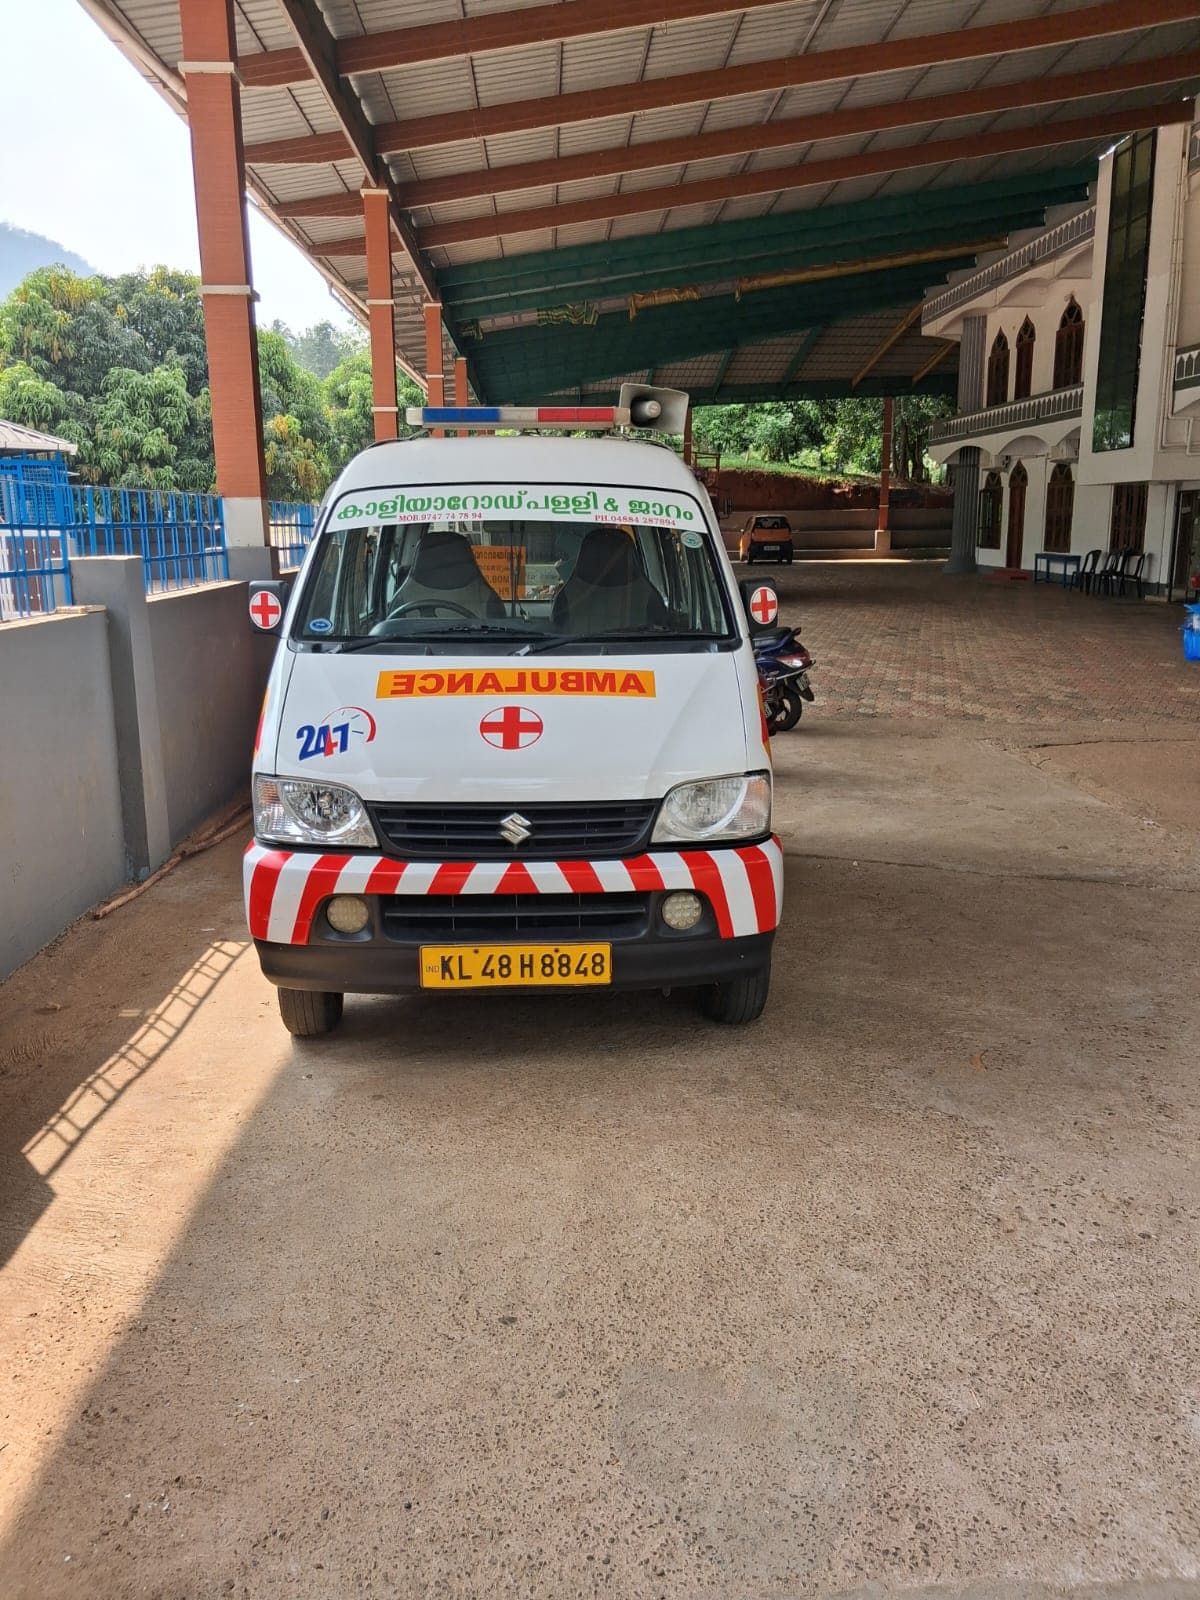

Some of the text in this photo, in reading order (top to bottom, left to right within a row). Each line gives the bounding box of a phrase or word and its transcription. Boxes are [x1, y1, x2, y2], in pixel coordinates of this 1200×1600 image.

[603, 497, 619, 512] &
[628, 499, 694, 521] ജാറം
[440, 955, 472, 980] KL
[481, 954, 512, 978] 48
[541, 952, 605, 977] 8848
